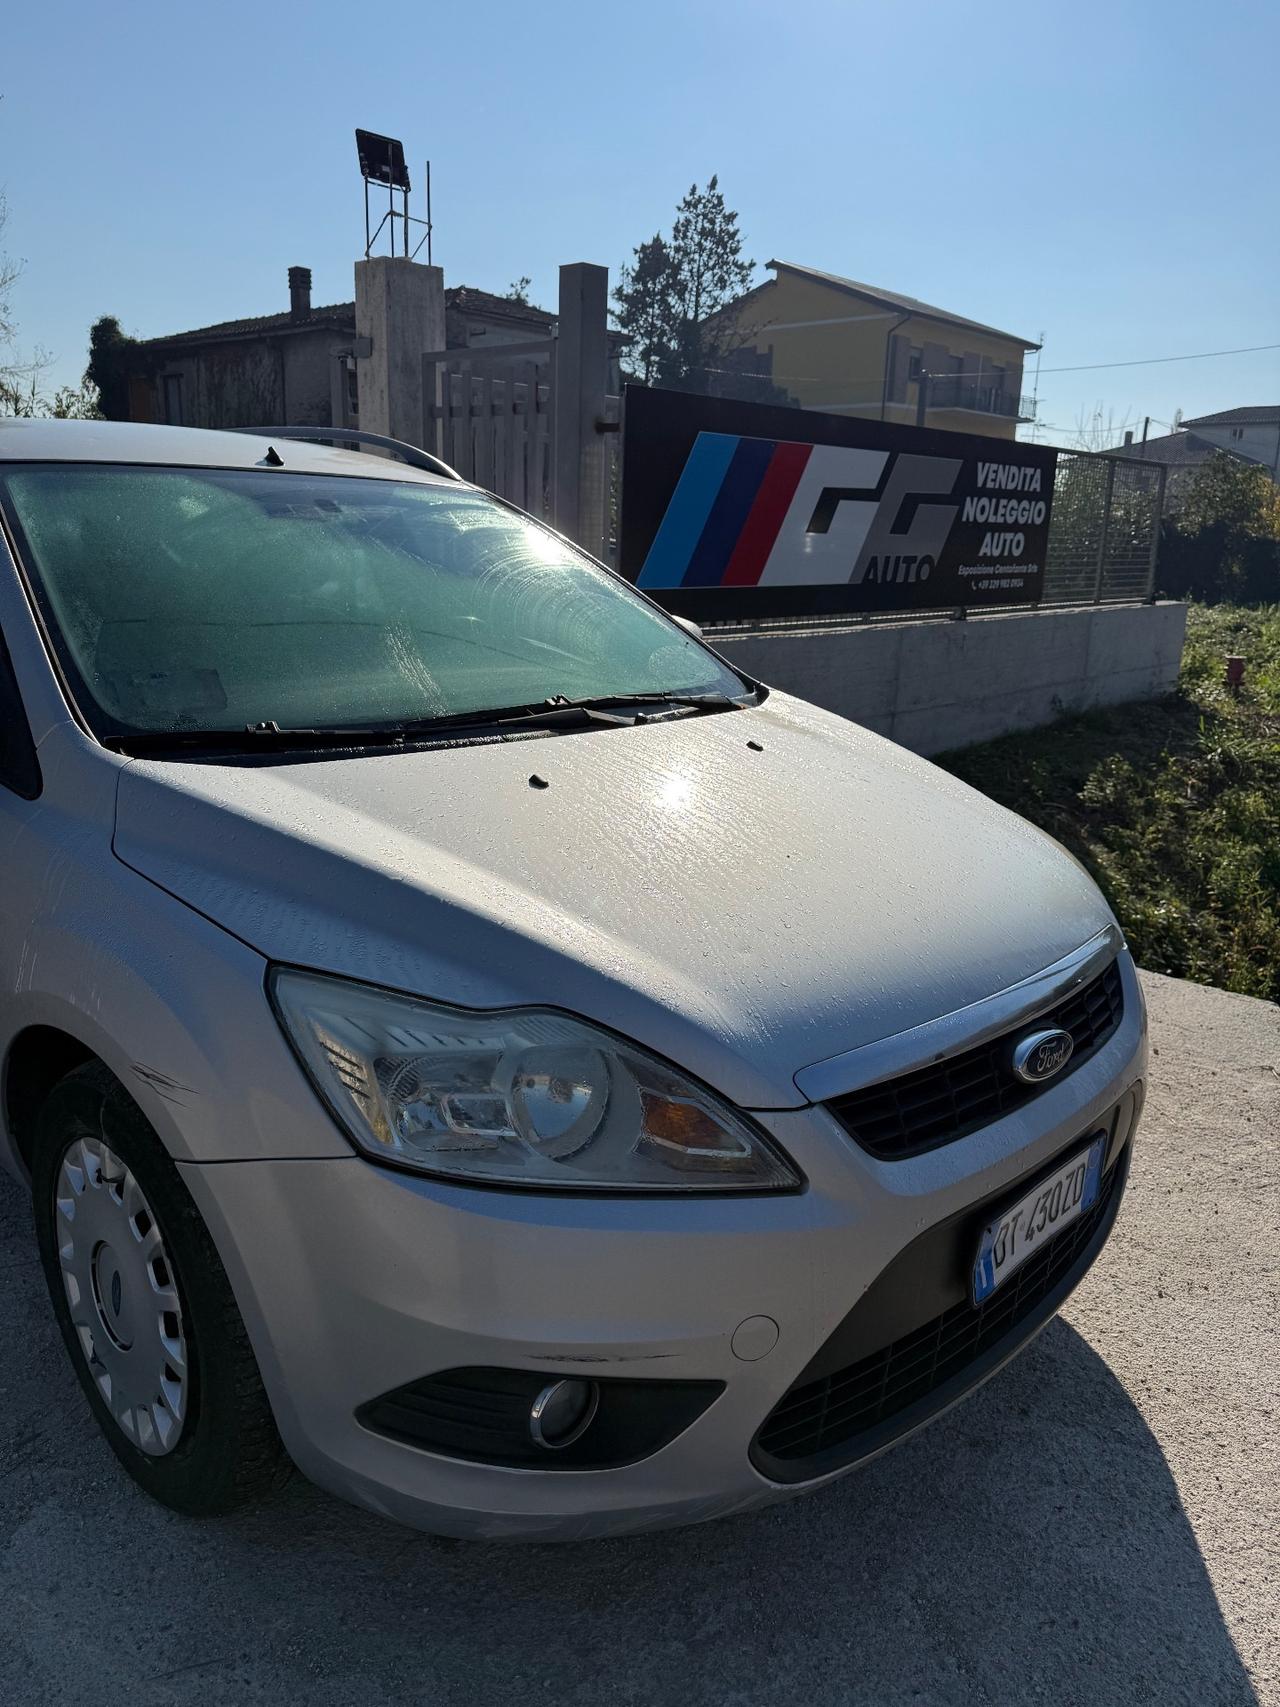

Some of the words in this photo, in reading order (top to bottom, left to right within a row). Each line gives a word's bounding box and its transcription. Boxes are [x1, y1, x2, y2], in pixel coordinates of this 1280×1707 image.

[977, 461, 1041, 492] VENDITA
[961, 496, 1046, 525] NOLEGGIO
[978, 532, 1025, 557] AUTO
[859, 554, 935, 584] AUTO
[1037, 1041, 1065, 1072] Ford
